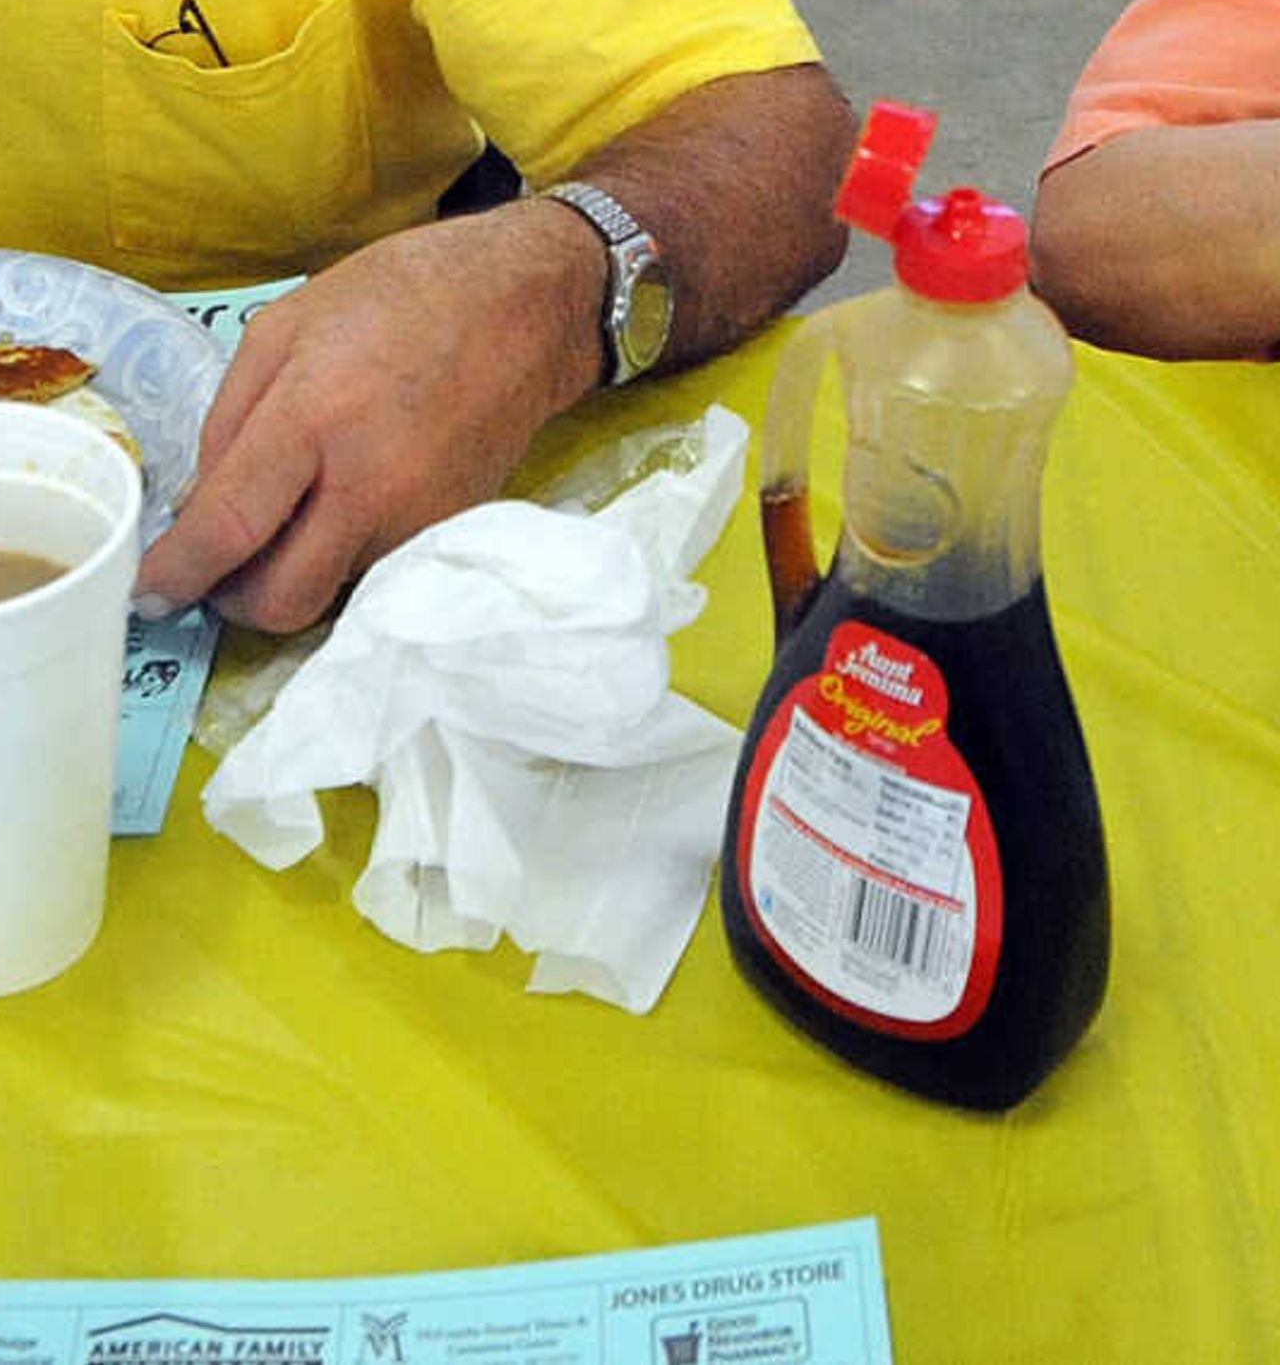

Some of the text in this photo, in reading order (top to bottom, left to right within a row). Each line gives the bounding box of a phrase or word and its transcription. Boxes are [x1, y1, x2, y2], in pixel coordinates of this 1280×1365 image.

[860, 641, 915, 684] Aunt
[819, 674, 942, 748] Original
[610, 1259, 845, 1312] JONES DRUG STORE
[89, 1340, 325, 1360] AMERICAN FAMILY
